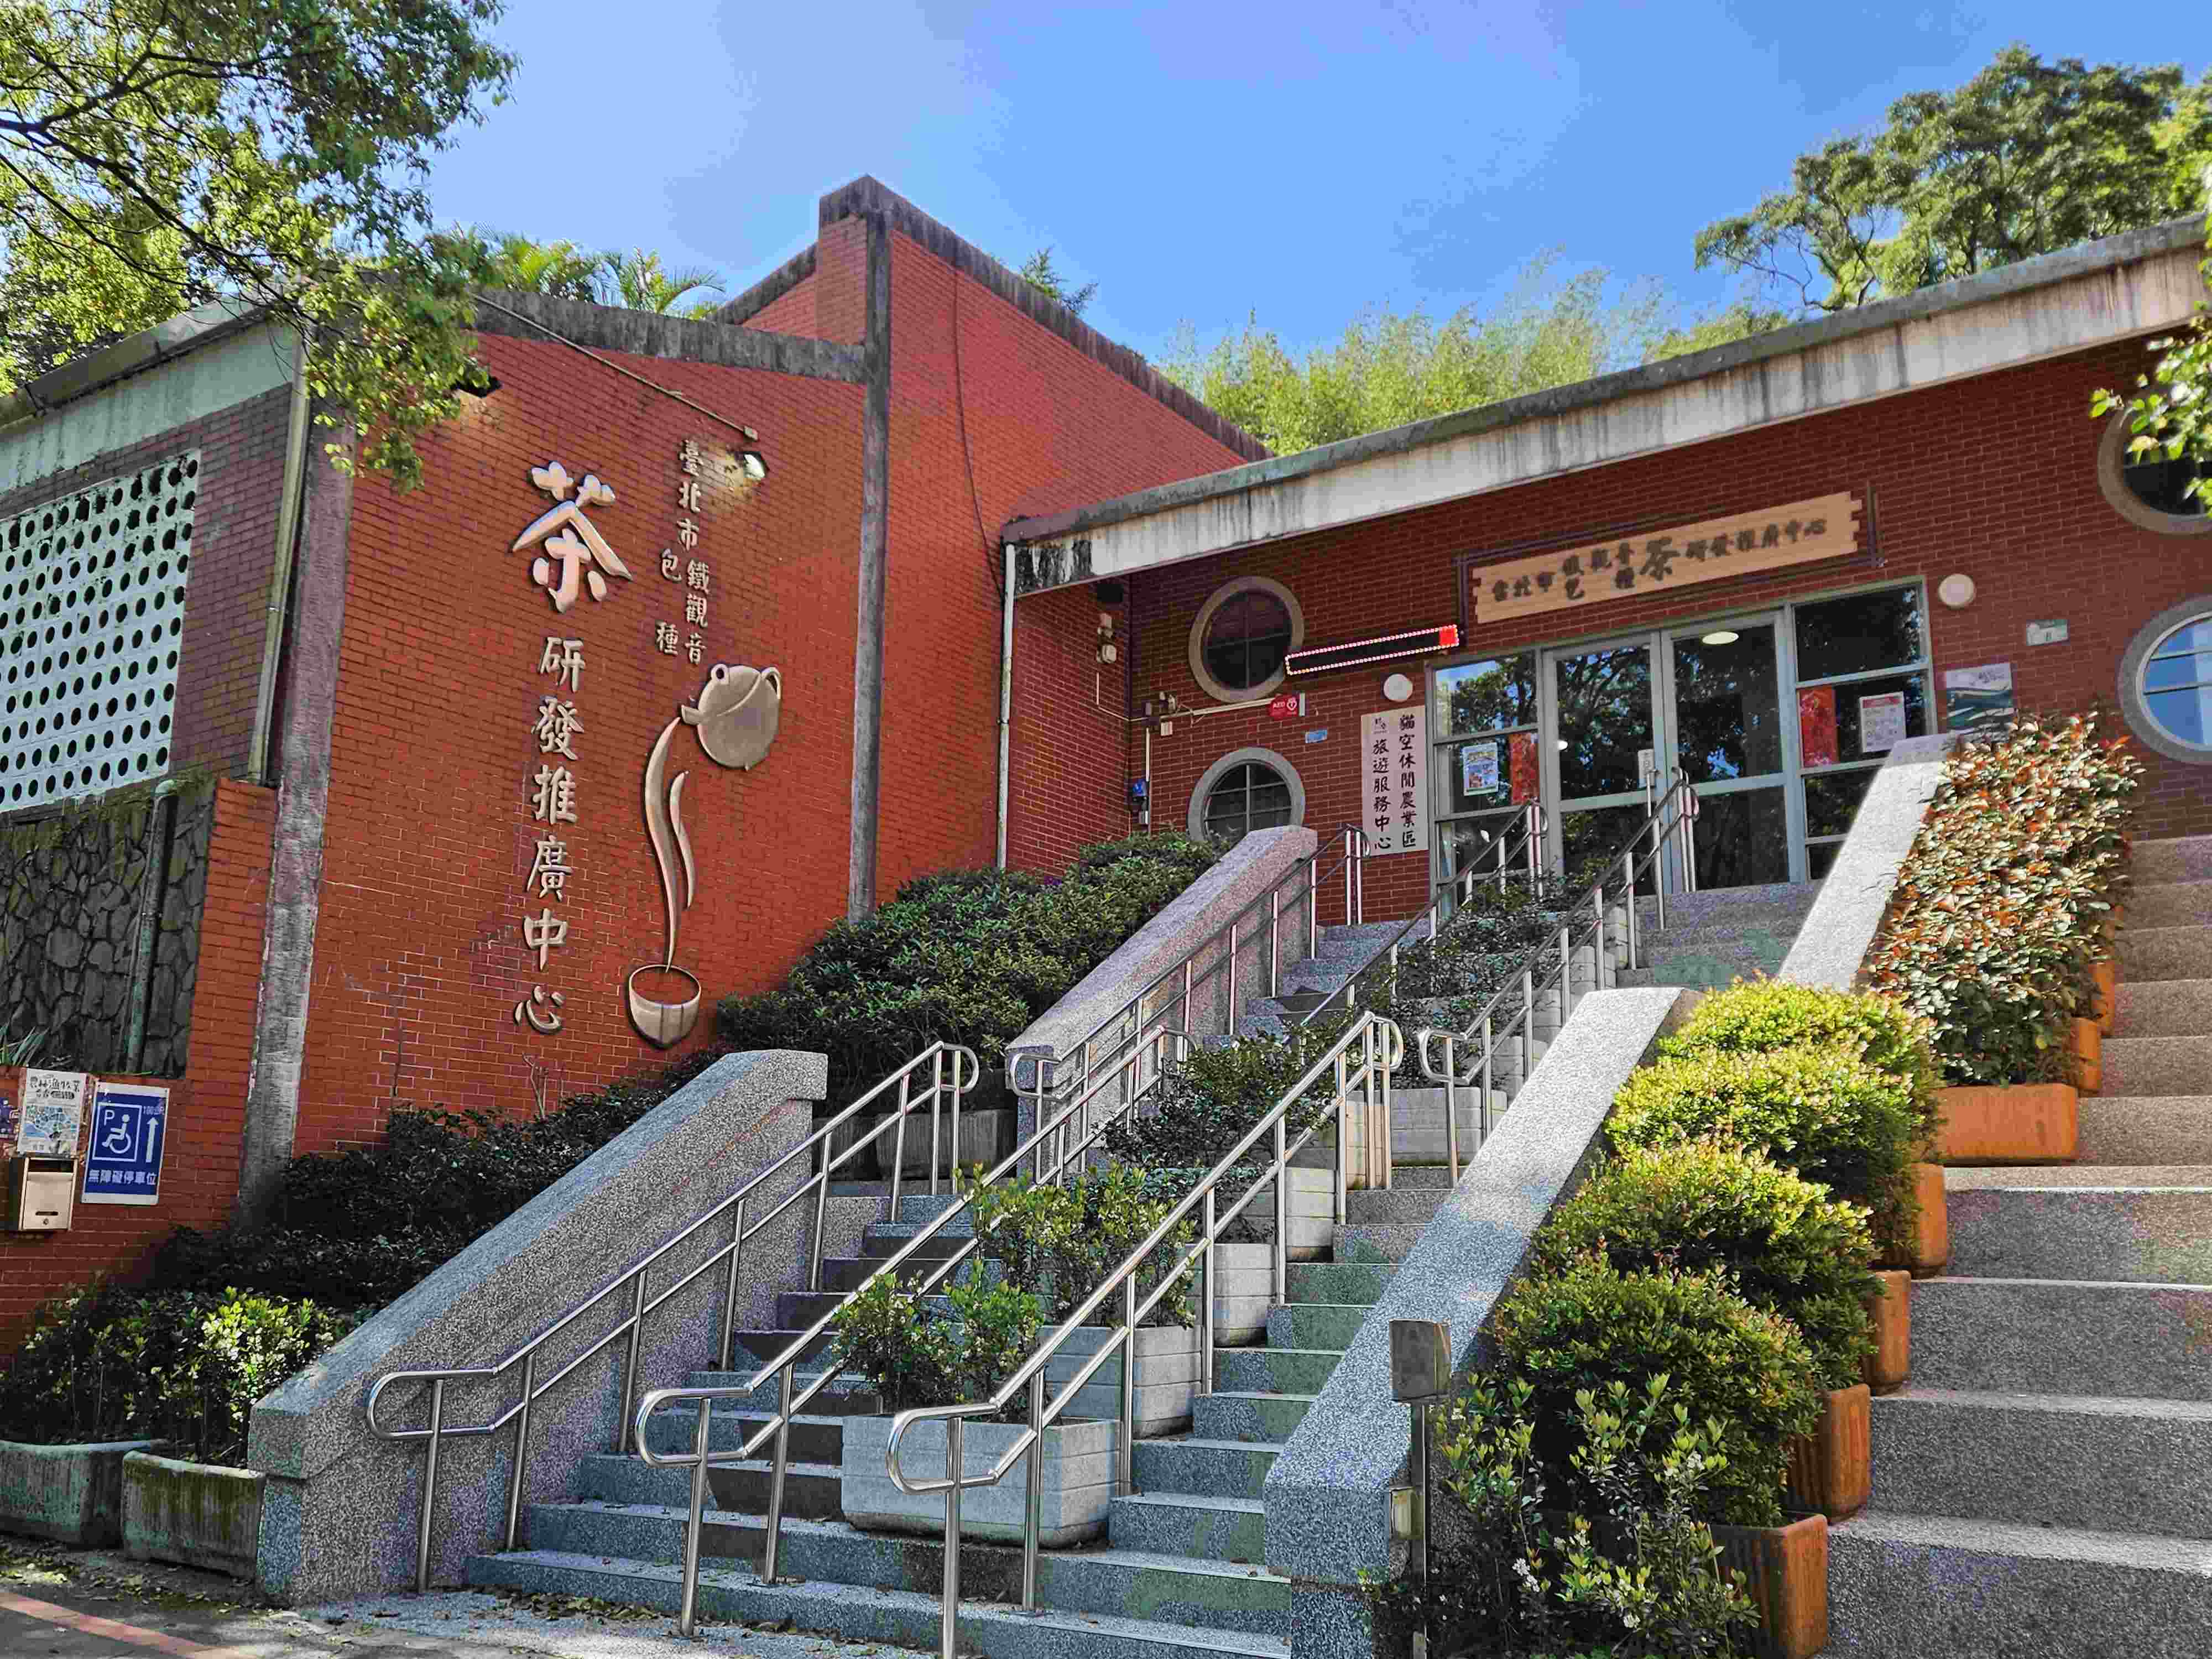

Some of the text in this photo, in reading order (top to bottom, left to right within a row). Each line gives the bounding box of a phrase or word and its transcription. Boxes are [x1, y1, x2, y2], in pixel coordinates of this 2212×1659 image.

[677, 440, 703, 551] 臺北市
[655, 548, 681, 656] 包種
[685, 559, 710, 665] 鐵觀音
[1372, 738, 1391, 849] 旅遊服務中心
[103, 1109, 115, 1125] P
